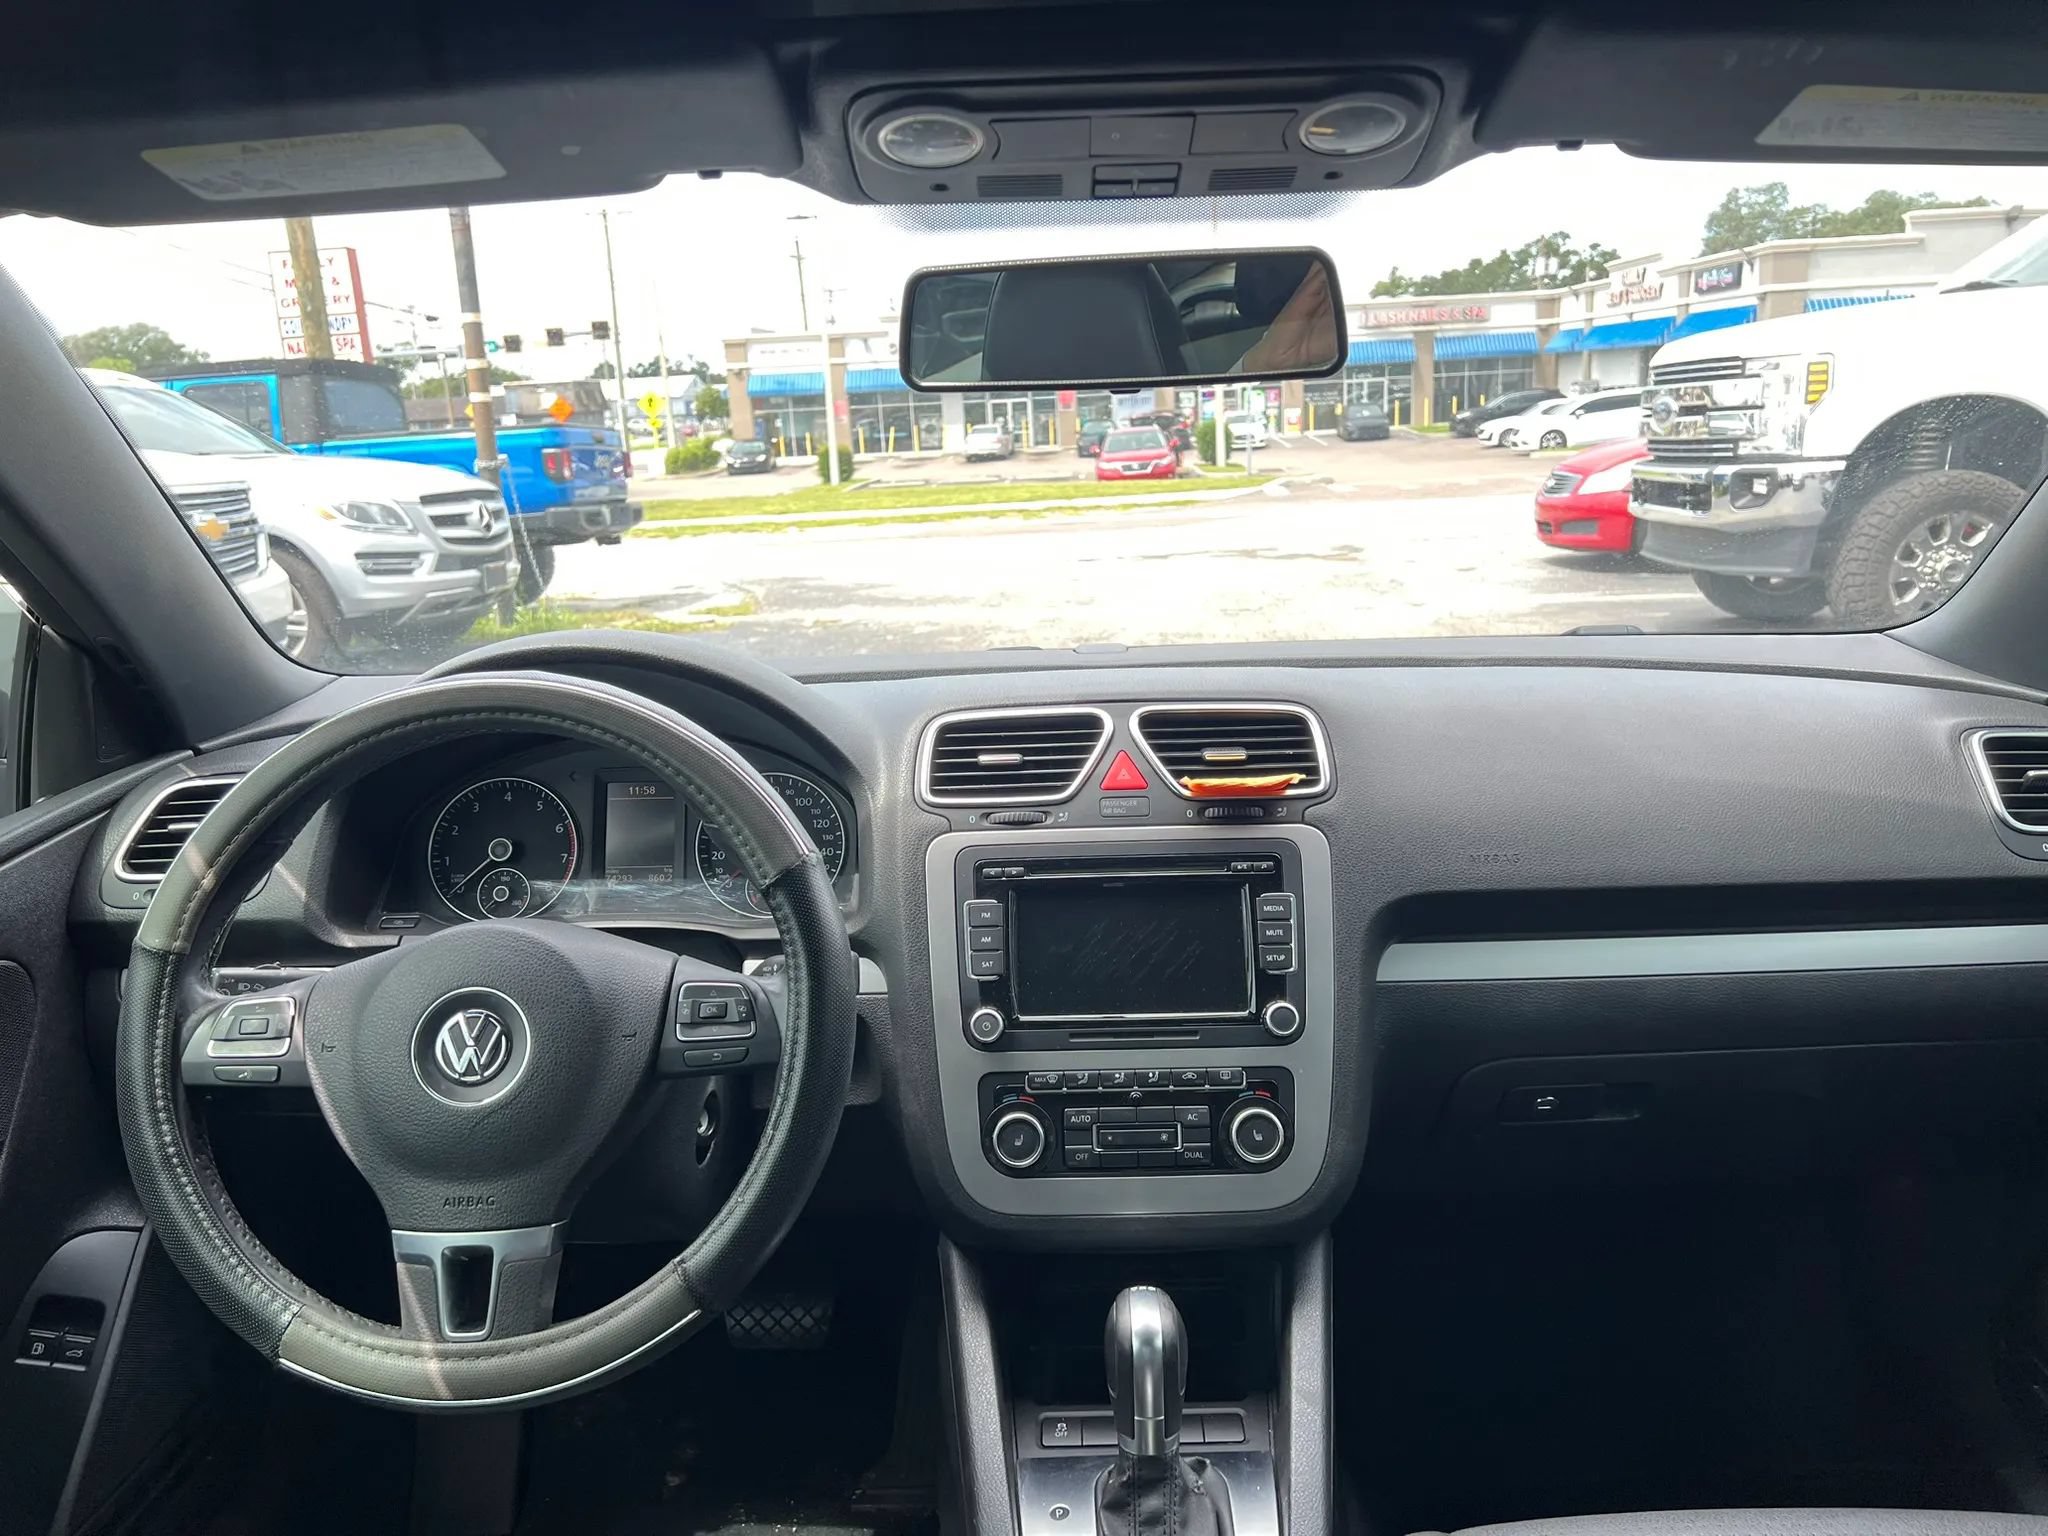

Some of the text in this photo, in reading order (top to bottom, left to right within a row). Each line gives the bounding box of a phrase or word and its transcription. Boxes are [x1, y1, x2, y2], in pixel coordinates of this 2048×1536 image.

[629, 786, 656, 795] 11:58
[505, 792, 512, 801] 4
[537, 801, 543, 811] 5
[795, 797, 813, 807] 100
[473, 803, 479, 812] 3
[813, 819, 830, 828] 120
[452, 826, 459, 835] 2
[555, 824, 563, 833] 6
[711, 851, 725, 860] 20
[820, 848, 834, 856] 40
[445, 857, 450, 866] 1
[561, 854, 568, 863] 7
[1266, 954, 1286, 962] SETUP
[706, 1006, 718, 1014] OK
[1070, 1115, 1091, 1123] AUTO
[1187, 1113, 1198, 1121] AC
[1075, 1153, 1089, 1161] OFF
[1184, 1151, 1204, 1159] DUAL
[443, 1195, 496, 1208] AIRBAG
